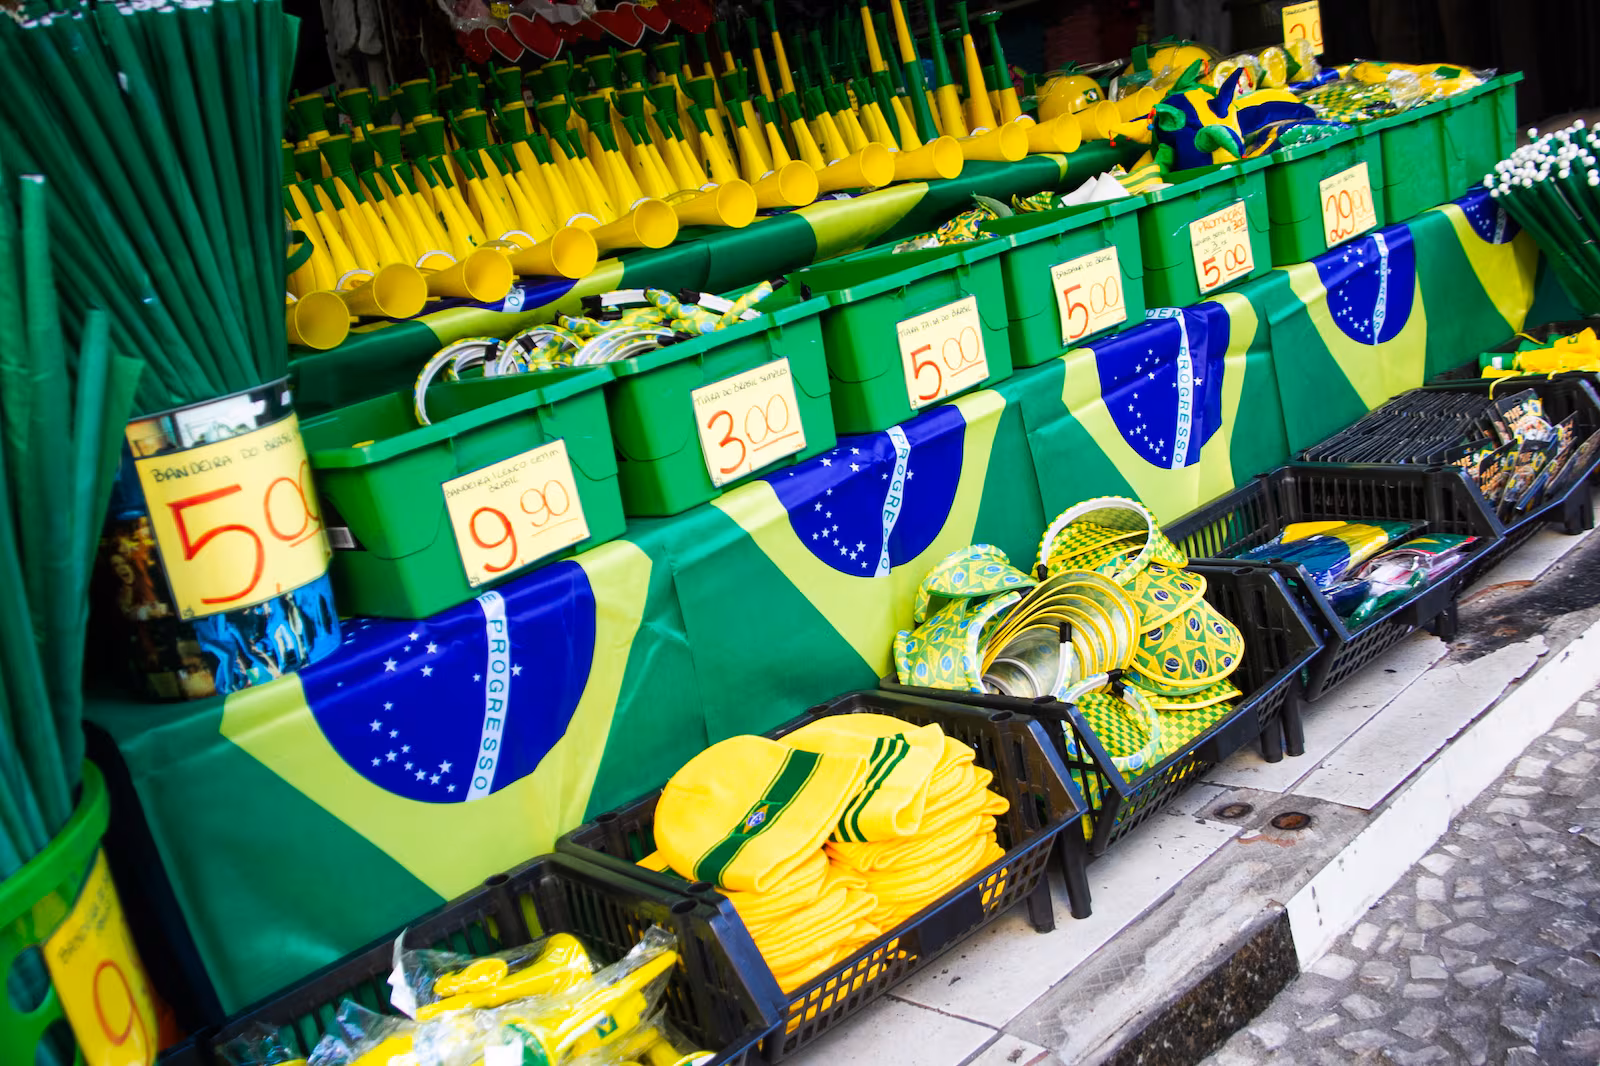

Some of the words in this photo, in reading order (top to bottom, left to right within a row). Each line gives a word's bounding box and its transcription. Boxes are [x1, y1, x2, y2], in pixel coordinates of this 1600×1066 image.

[1146, 308, 1181, 318] DEM
[696, 391, 721, 406] TIARA
[722, 387, 732, 397] DO
[734, 379, 758, 393] BRASIL
[1174, 346, 1191, 464] PROGRESSO
[151, 453, 233, 483] BANDEIRA
[240, 446, 259, 460] DO
[446, 476, 491, 499] BANDEIRA
[488, 476, 519, 493] BRASIL
[473, 619, 507, 791] PROGRESSO
